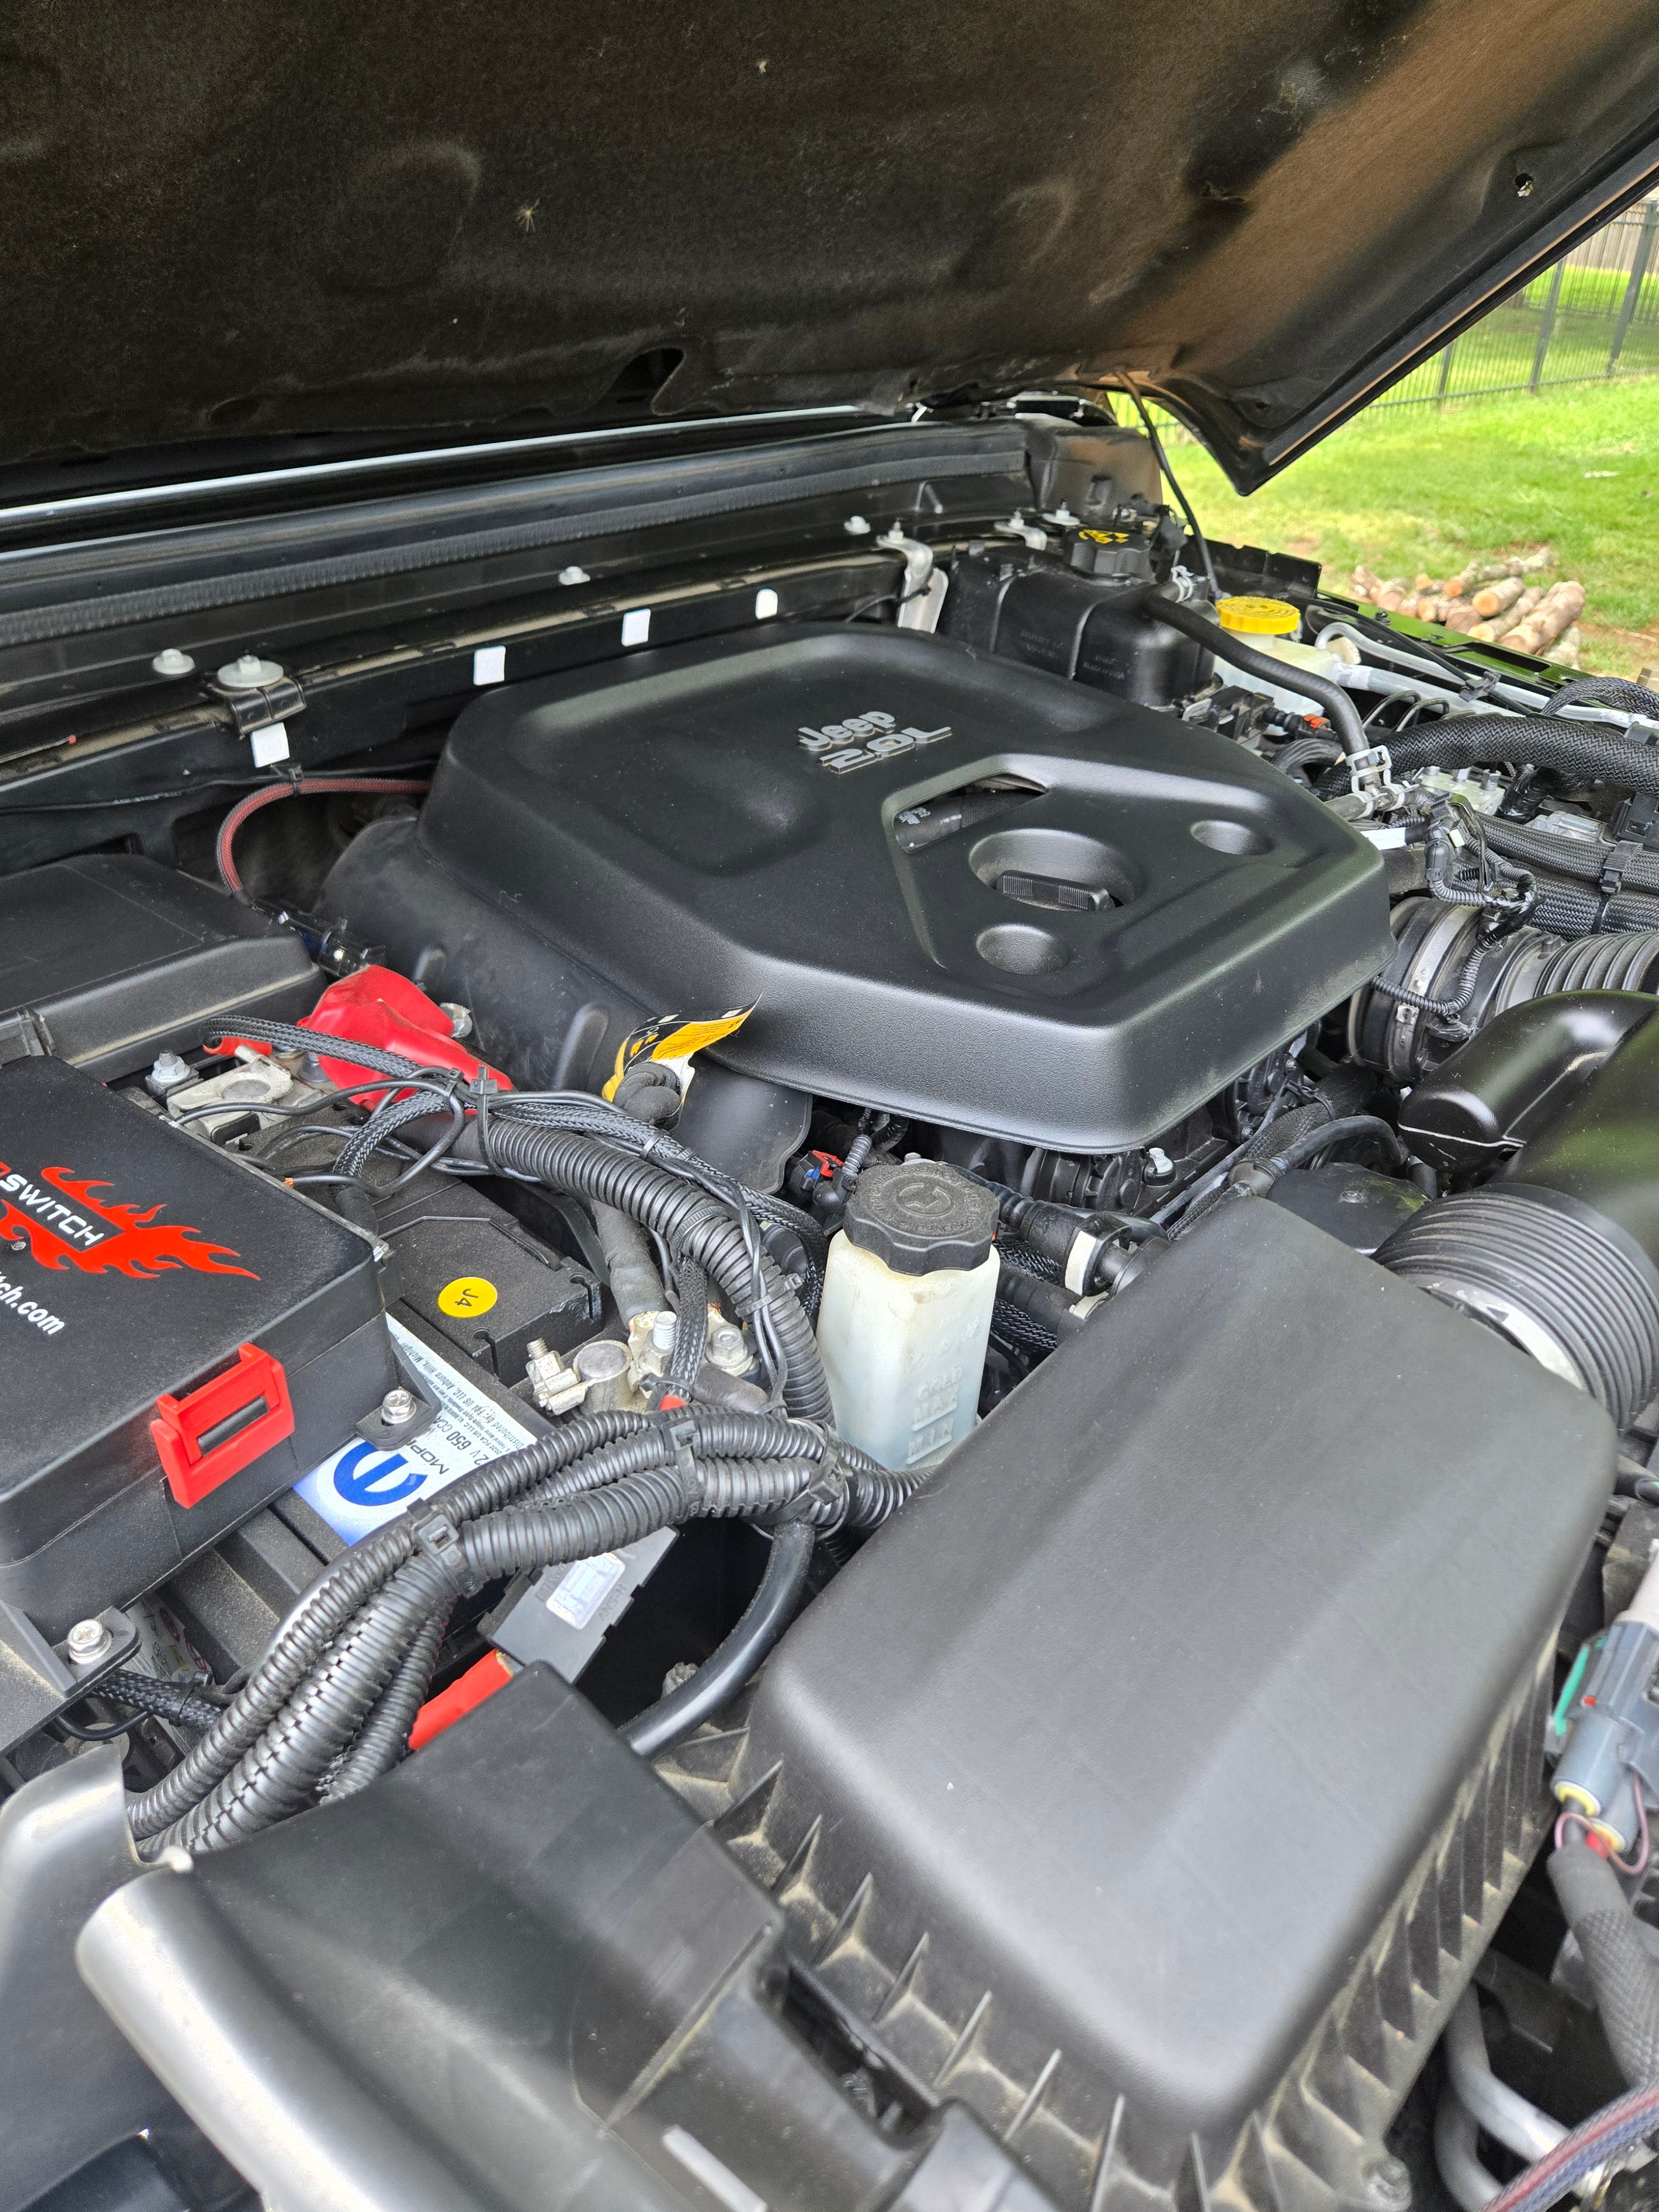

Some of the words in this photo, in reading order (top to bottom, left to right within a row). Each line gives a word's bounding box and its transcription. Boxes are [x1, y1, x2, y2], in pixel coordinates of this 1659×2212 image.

[797, 711, 896, 752] Jeep
[819, 726, 952, 774] 2.0L
[0, 1275, 65, 1334] ch.com
[455, 1288, 479, 1307] J4
[401, 1342, 424, 1363] Michigan
[423, 1360, 437, 1374] Hills,
[435, 1371, 456, 1390] Auburn
[918, 1365, 963, 1401] COLD
[453, 1387, 467, 1400] LLC,
[463, 1397, 474, 1407] US
[915, 1384, 960, 1420] MAX
[471, 1404, 486, 1415] FCA
[483, 1412, 495, 1424] by:
[434, 1416, 453, 1432] CCA
[463, 1422, 475, 1432] LLC
[446, 1431, 472, 1450] 650
[480, 1436, 492, 1446] FCA
[491, 1422, 524, 1450] Distributed
[469, 1450, 481, 1458] V
[489, 1444, 502, 1454] 2020
[407, 1441, 450, 1475] MOP
[474, 1454, 489, 1465] 2
